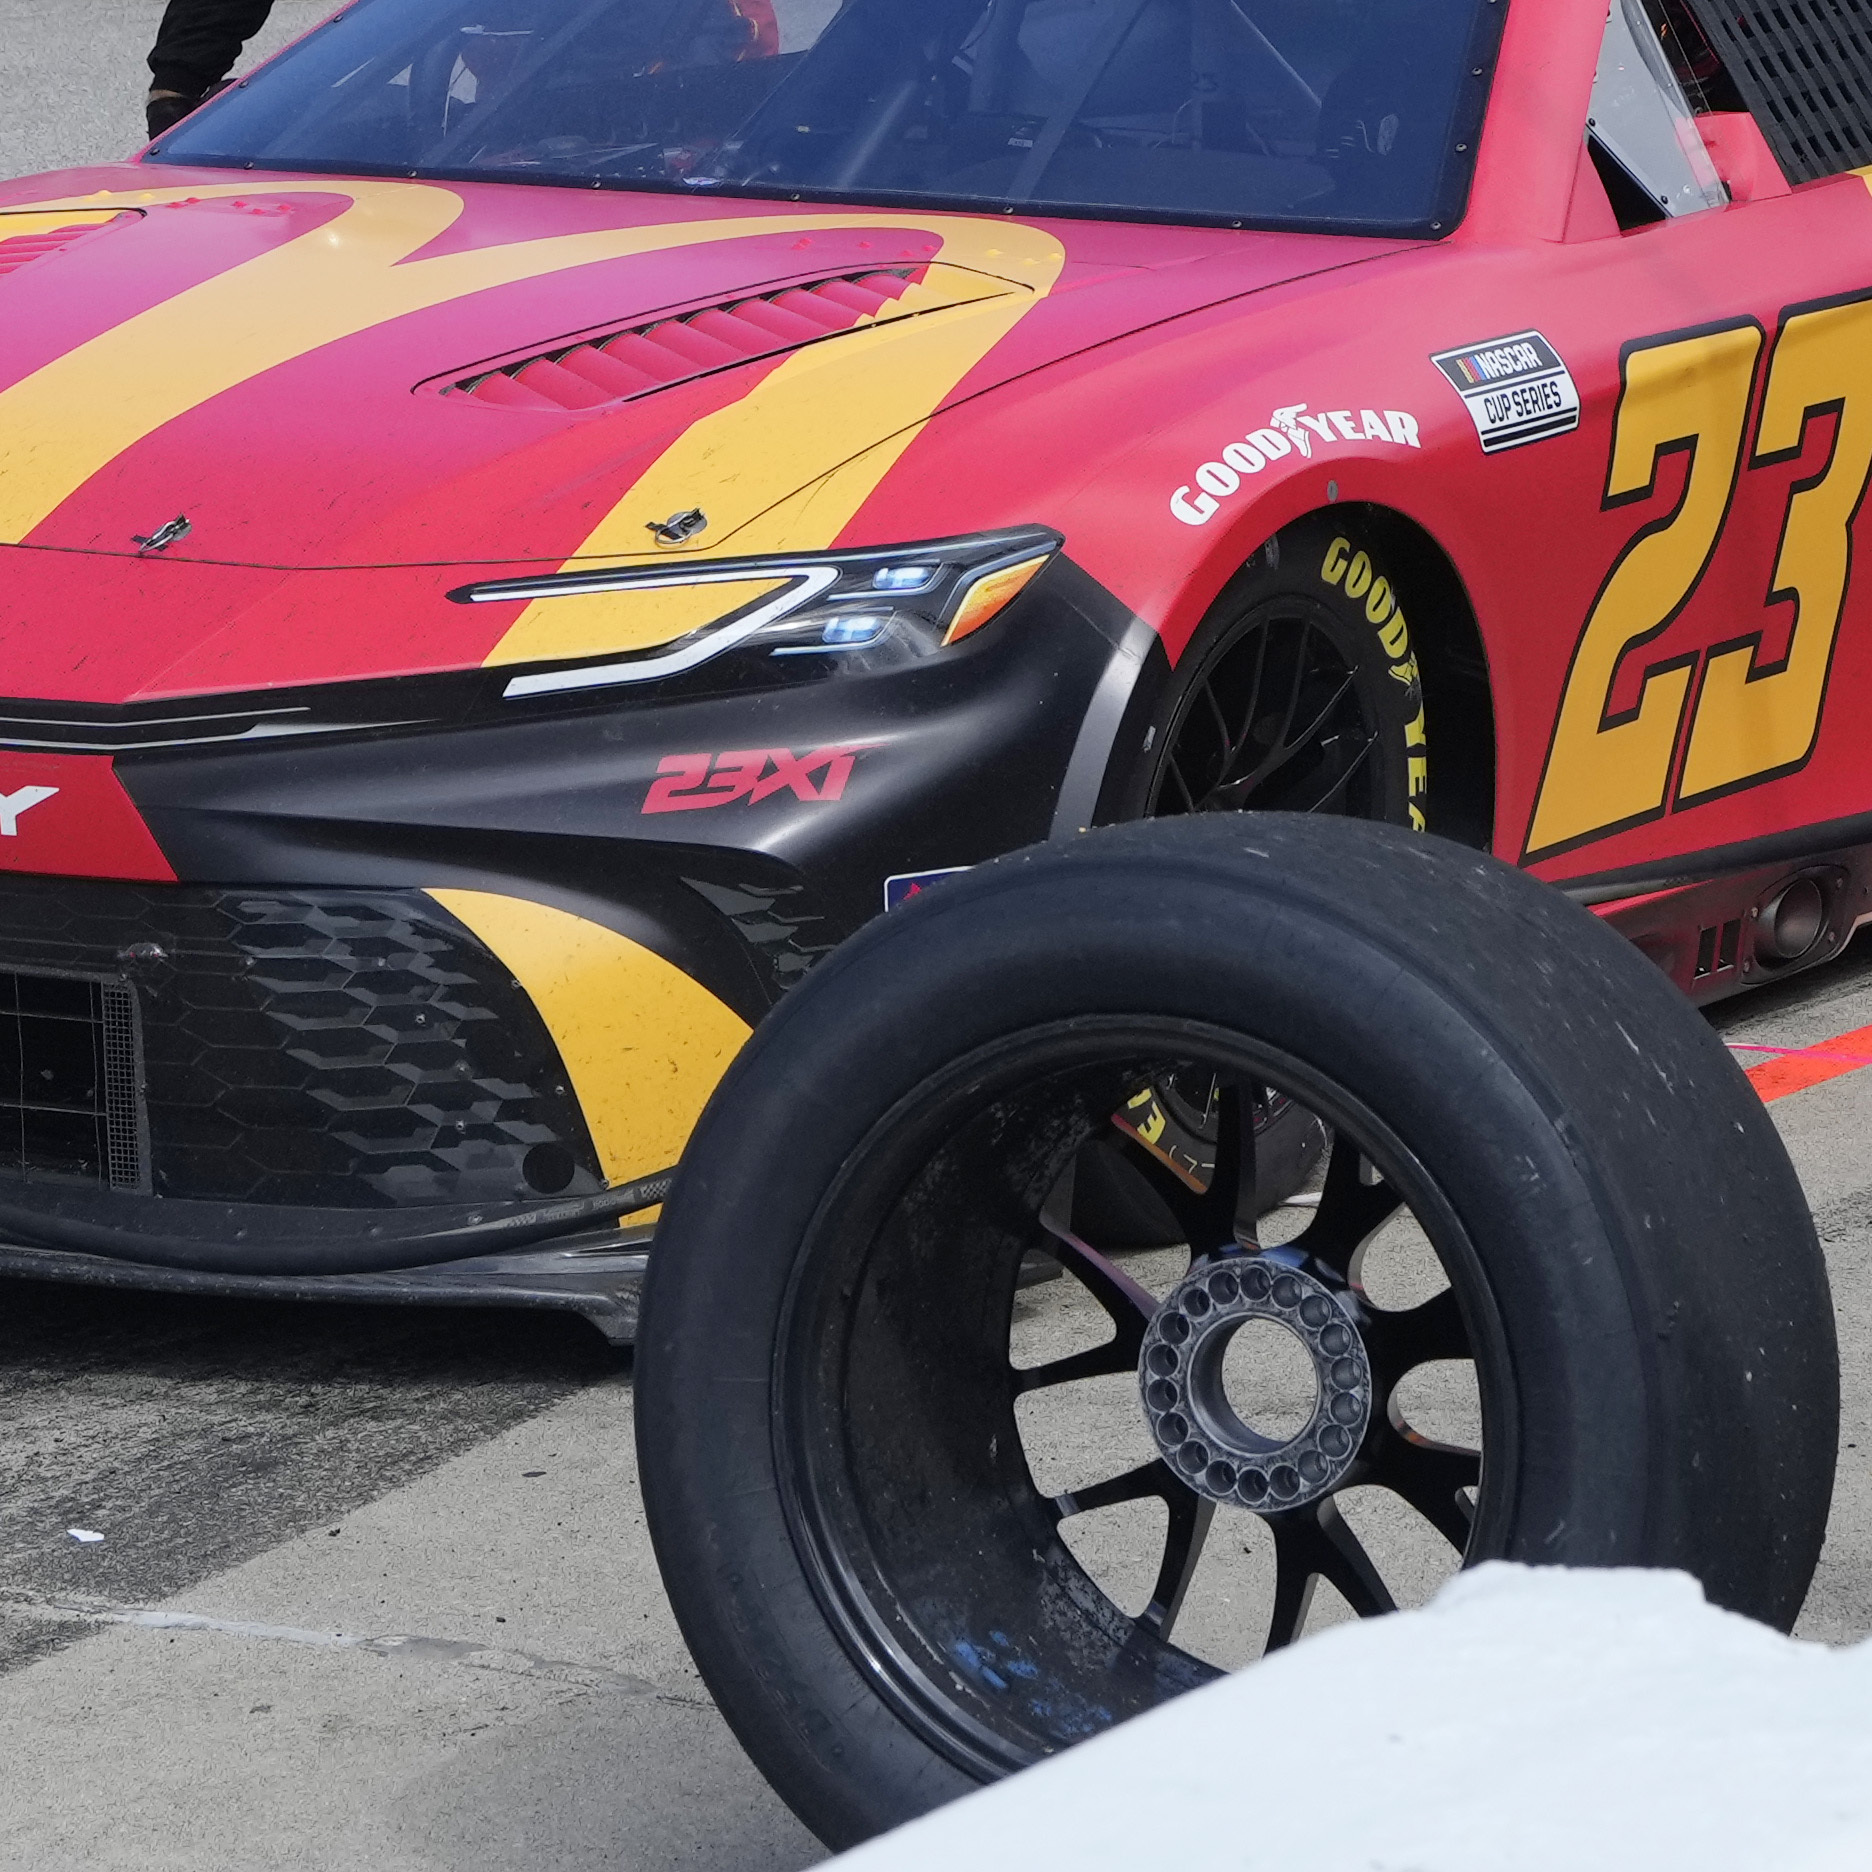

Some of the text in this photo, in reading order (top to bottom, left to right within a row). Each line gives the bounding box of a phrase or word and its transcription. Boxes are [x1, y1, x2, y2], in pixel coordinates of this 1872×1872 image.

[1475, 343, 1545, 382] NASCAR
[1483, 381, 1562, 426] CUP SERIES
[1169, 403, 1423, 527] GOODYEAR
[1320, 536, 1427, 833] GOODYE
[639, 742, 887, 816] 23XI
